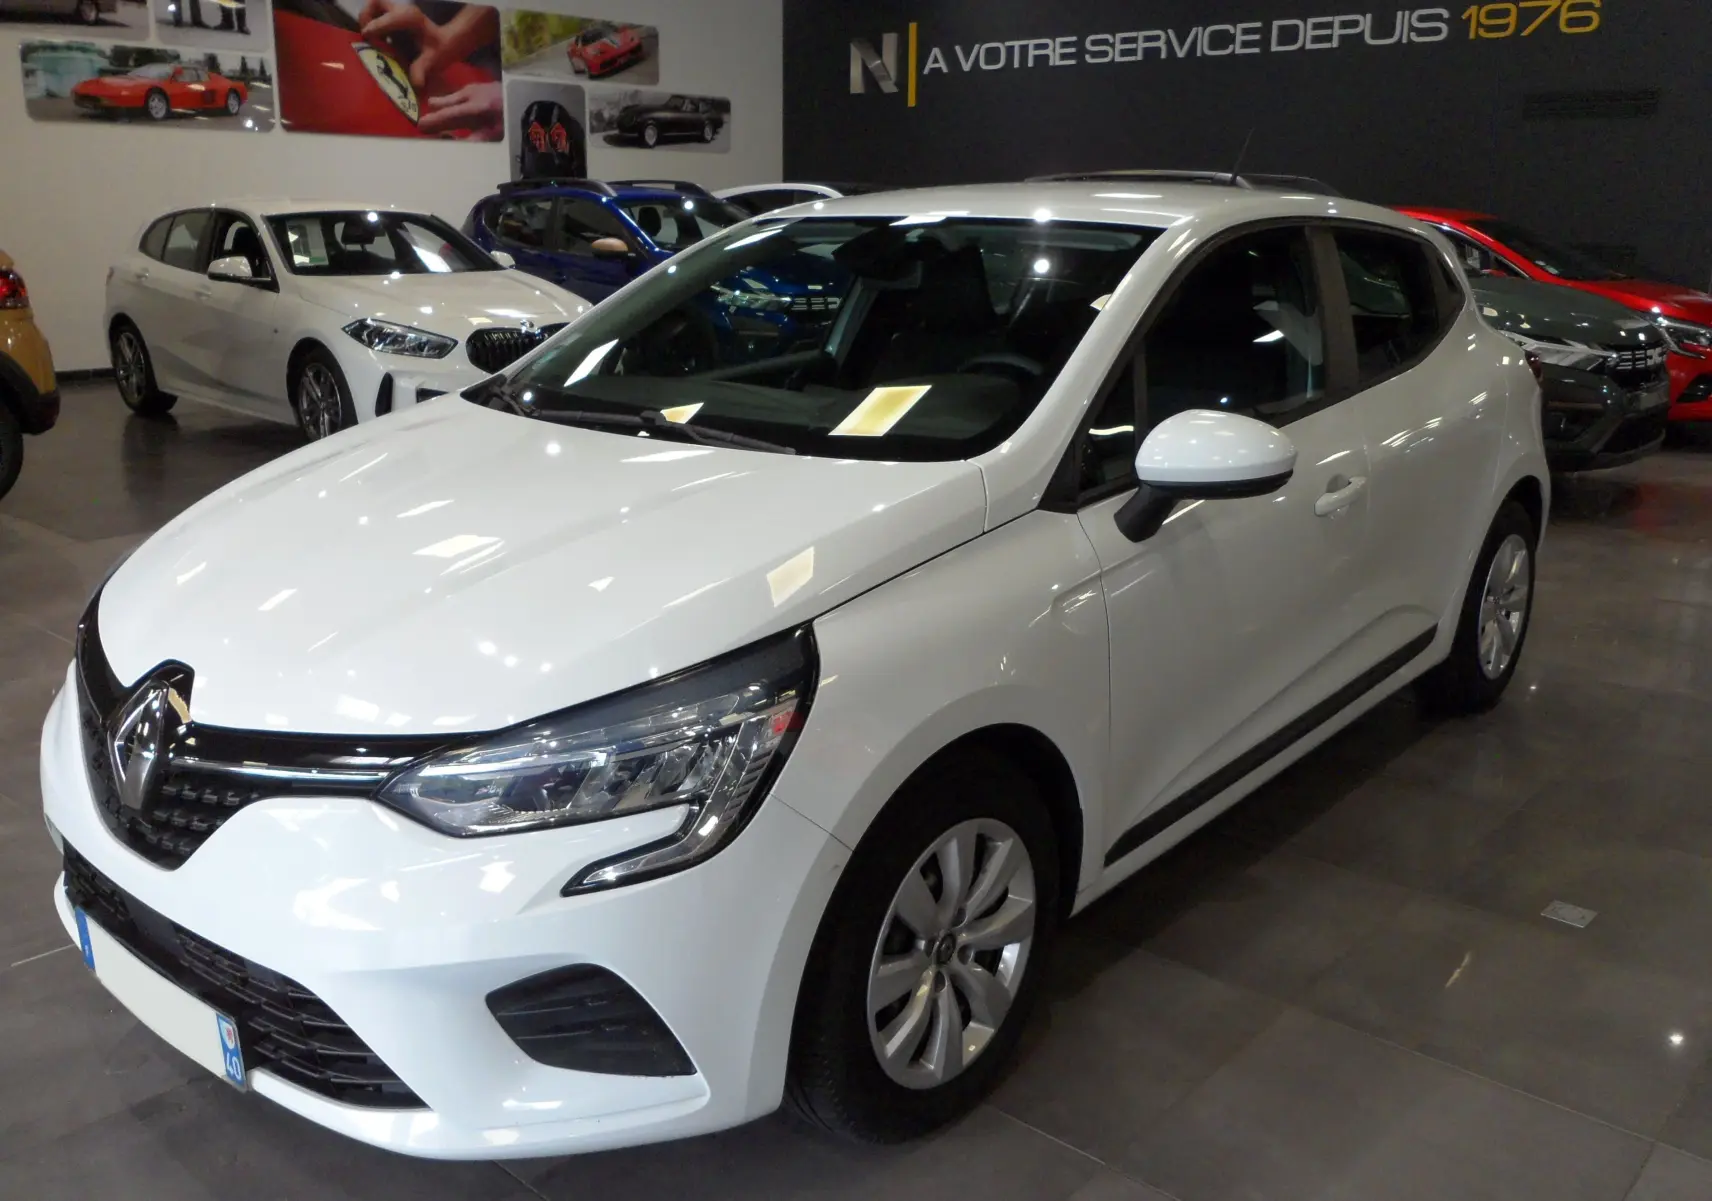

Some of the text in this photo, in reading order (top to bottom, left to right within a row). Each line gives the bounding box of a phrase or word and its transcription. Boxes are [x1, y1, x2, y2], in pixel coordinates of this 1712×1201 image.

[850, 33, 898, 93] N
[923, 0, 1601, 75] A VOTRE SERVICE DEPUIS 1976
[226, 1052, 242, 1080] 40
